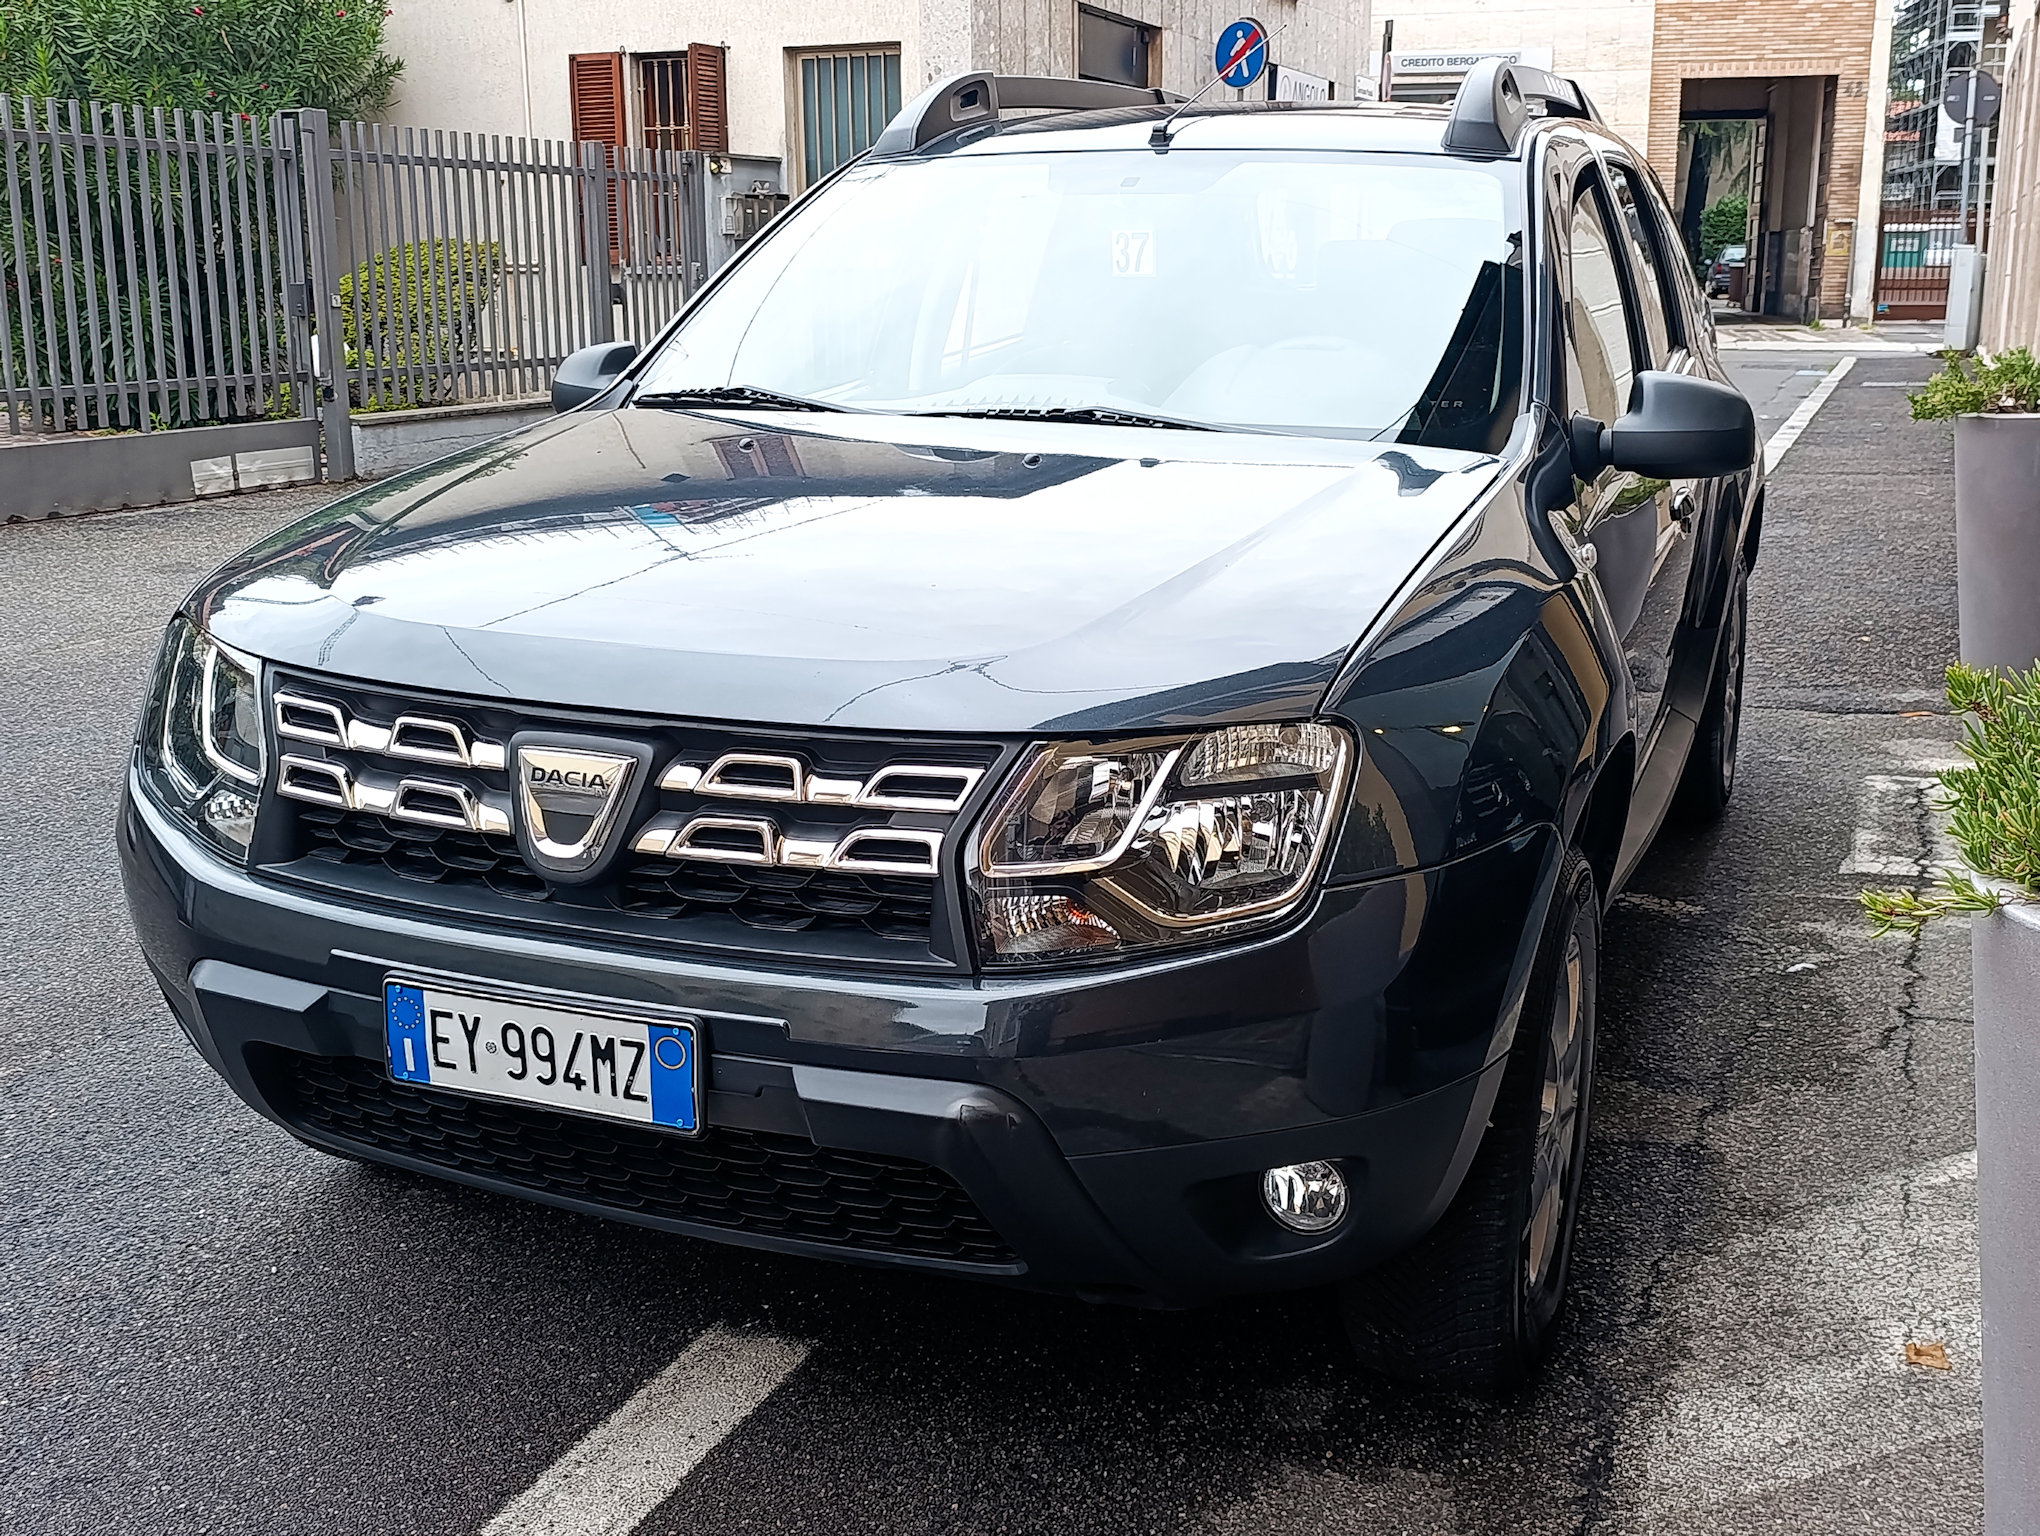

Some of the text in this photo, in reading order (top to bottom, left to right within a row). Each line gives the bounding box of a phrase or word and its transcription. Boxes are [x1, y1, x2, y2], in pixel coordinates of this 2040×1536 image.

[1401, 55, 1517, 67] CREDITO BERGAO
[1115, 231, 1149, 273] 37
[530, 767, 606, 790] DACIA
